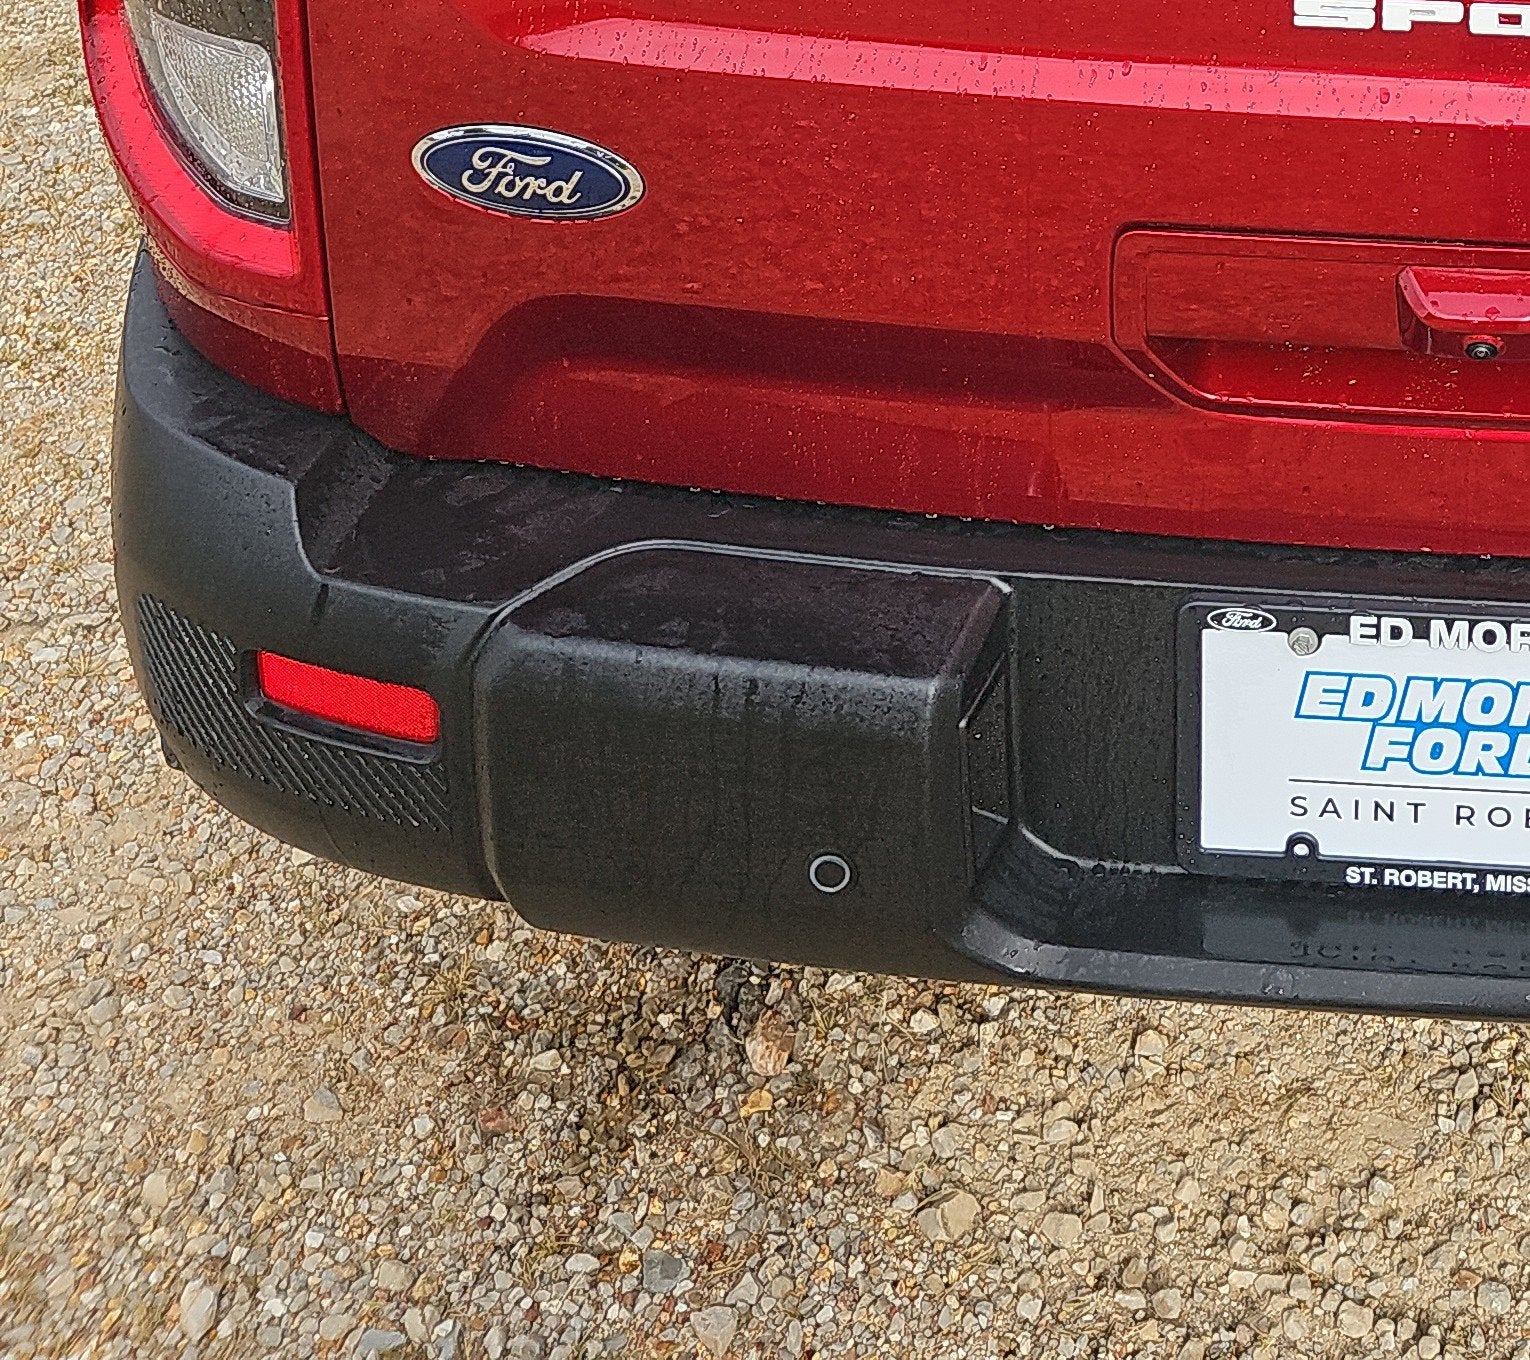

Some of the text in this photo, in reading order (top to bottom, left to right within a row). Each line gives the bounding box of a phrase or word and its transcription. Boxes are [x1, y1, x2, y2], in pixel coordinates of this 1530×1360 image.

[461, 146, 582, 204] Ford
[1221, 611, 1263, 629] Ford
[1350, 615, 1412, 647] ED
[1296, 671, 1393, 720] ED
[1289, 795, 1427, 824] SAINT
[1345, 866, 1378, 886] ST.
[1383, 869, 1480, 894] ROBERT,
